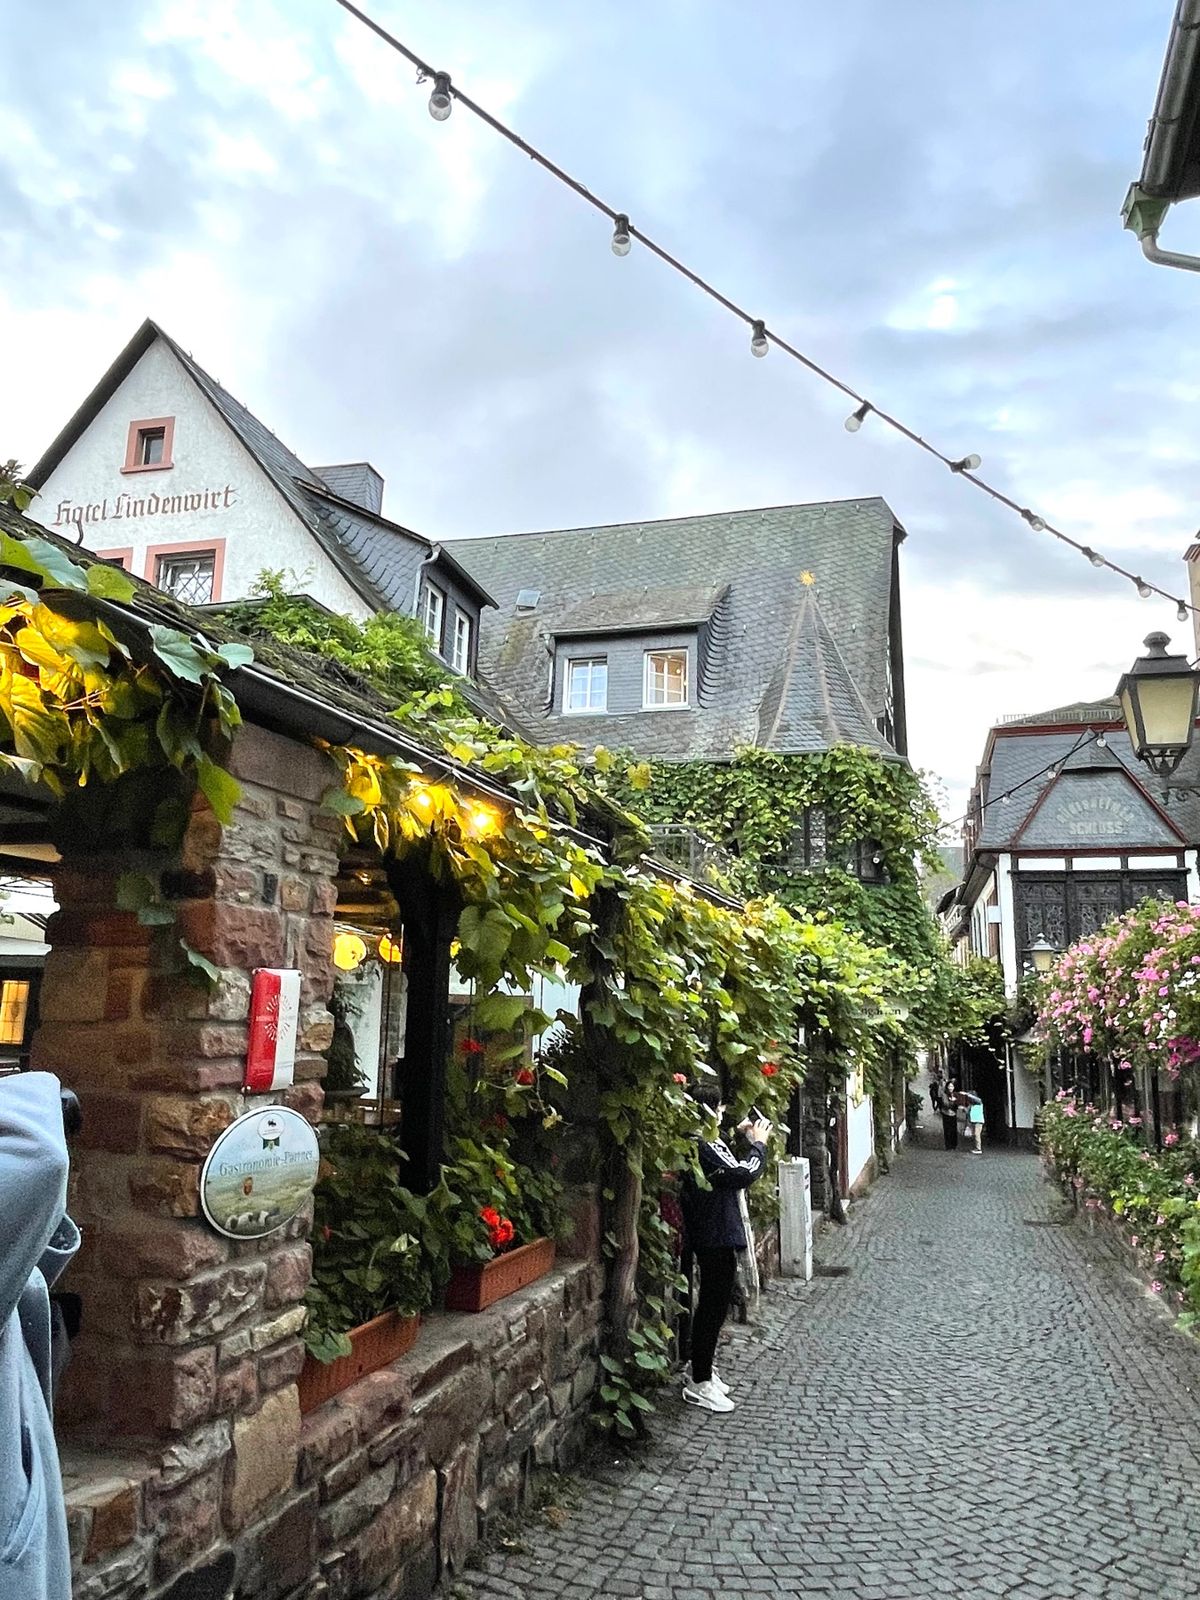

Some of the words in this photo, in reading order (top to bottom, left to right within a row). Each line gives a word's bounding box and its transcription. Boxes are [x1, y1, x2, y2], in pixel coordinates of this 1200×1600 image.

[52, 499, 107, 526] Hotel
[111, 484, 240, 519] Lindenwirt
[1069, 821, 1124, 835] SCHLOSS
